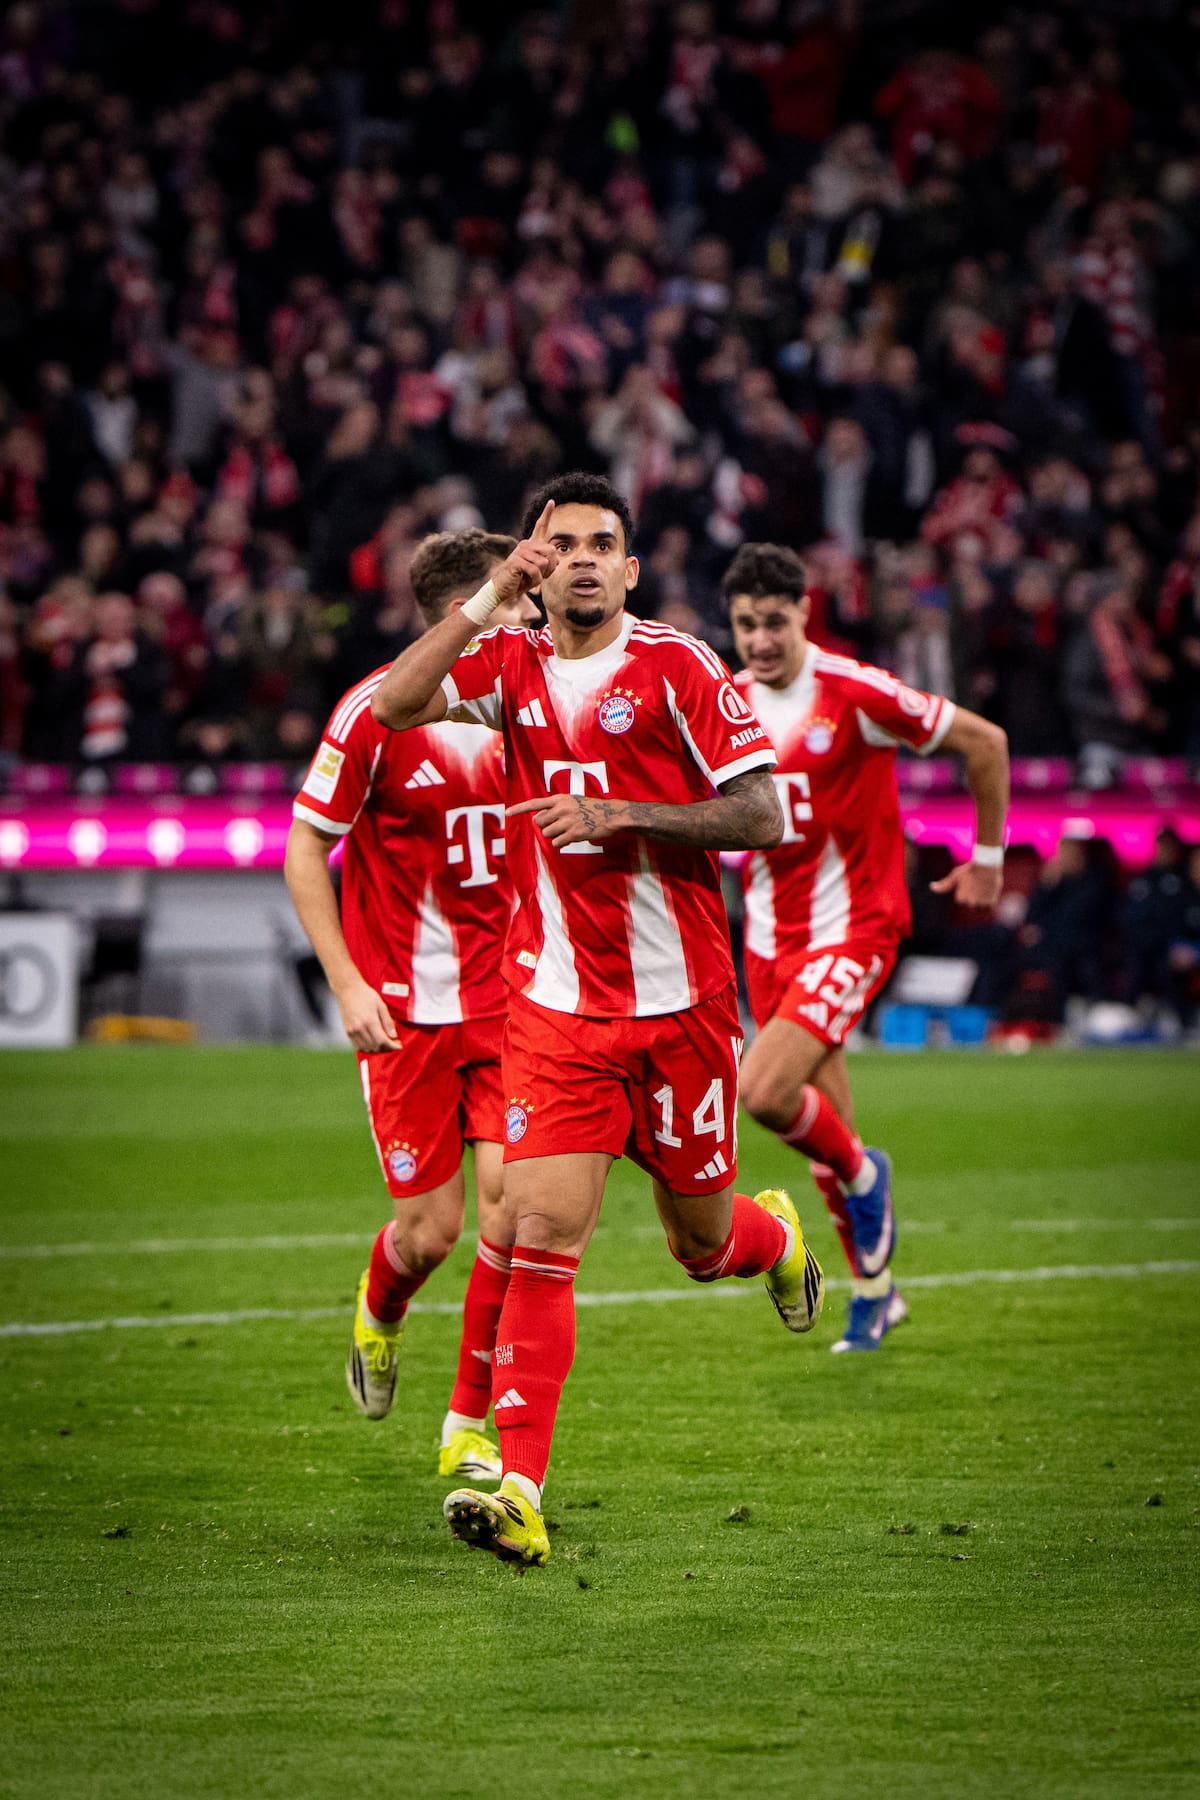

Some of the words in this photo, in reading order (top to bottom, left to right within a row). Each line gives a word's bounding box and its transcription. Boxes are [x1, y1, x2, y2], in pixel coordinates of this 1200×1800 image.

[609, 699, 632, 713] BAYERN
[543, 760, 610, 854] T
[796, 953, 865, 1008] 45
[653, 1078, 725, 1149] 14
[495, 1344, 513, 1353] MIA
[496, 1351, 513, 1360] SAN
[497, 1357, 514, 1367] MIA
